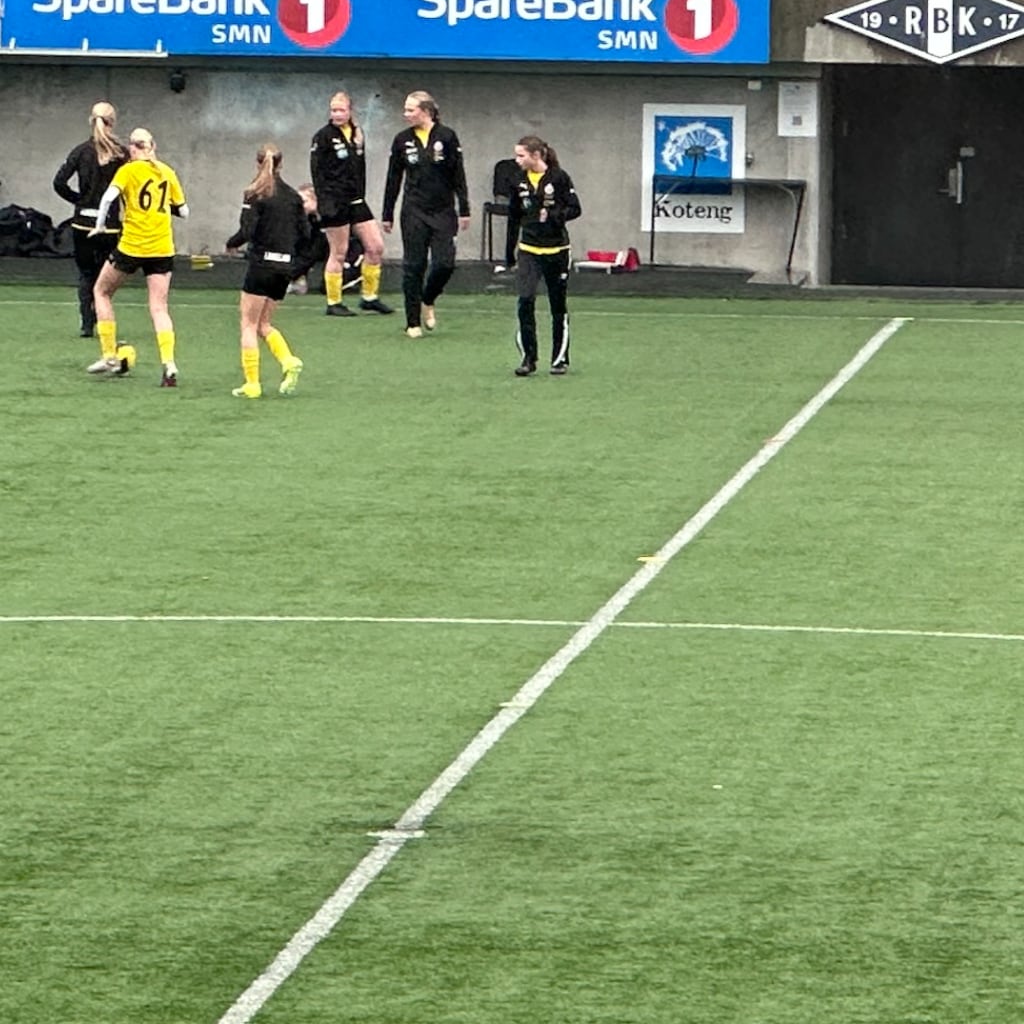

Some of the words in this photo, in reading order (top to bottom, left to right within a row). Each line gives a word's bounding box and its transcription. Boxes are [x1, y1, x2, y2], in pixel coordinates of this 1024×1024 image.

[212, 24, 271, 43] SMN
[860, 11, 882, 29] 19
[905, 6, 977, 38] RBK
[998, 12, 1020, 30] 17
[598, 30, 657, 49] SMN
[138, 178, 168, 213] 61
[654, 200, 733, 224] Koteng
